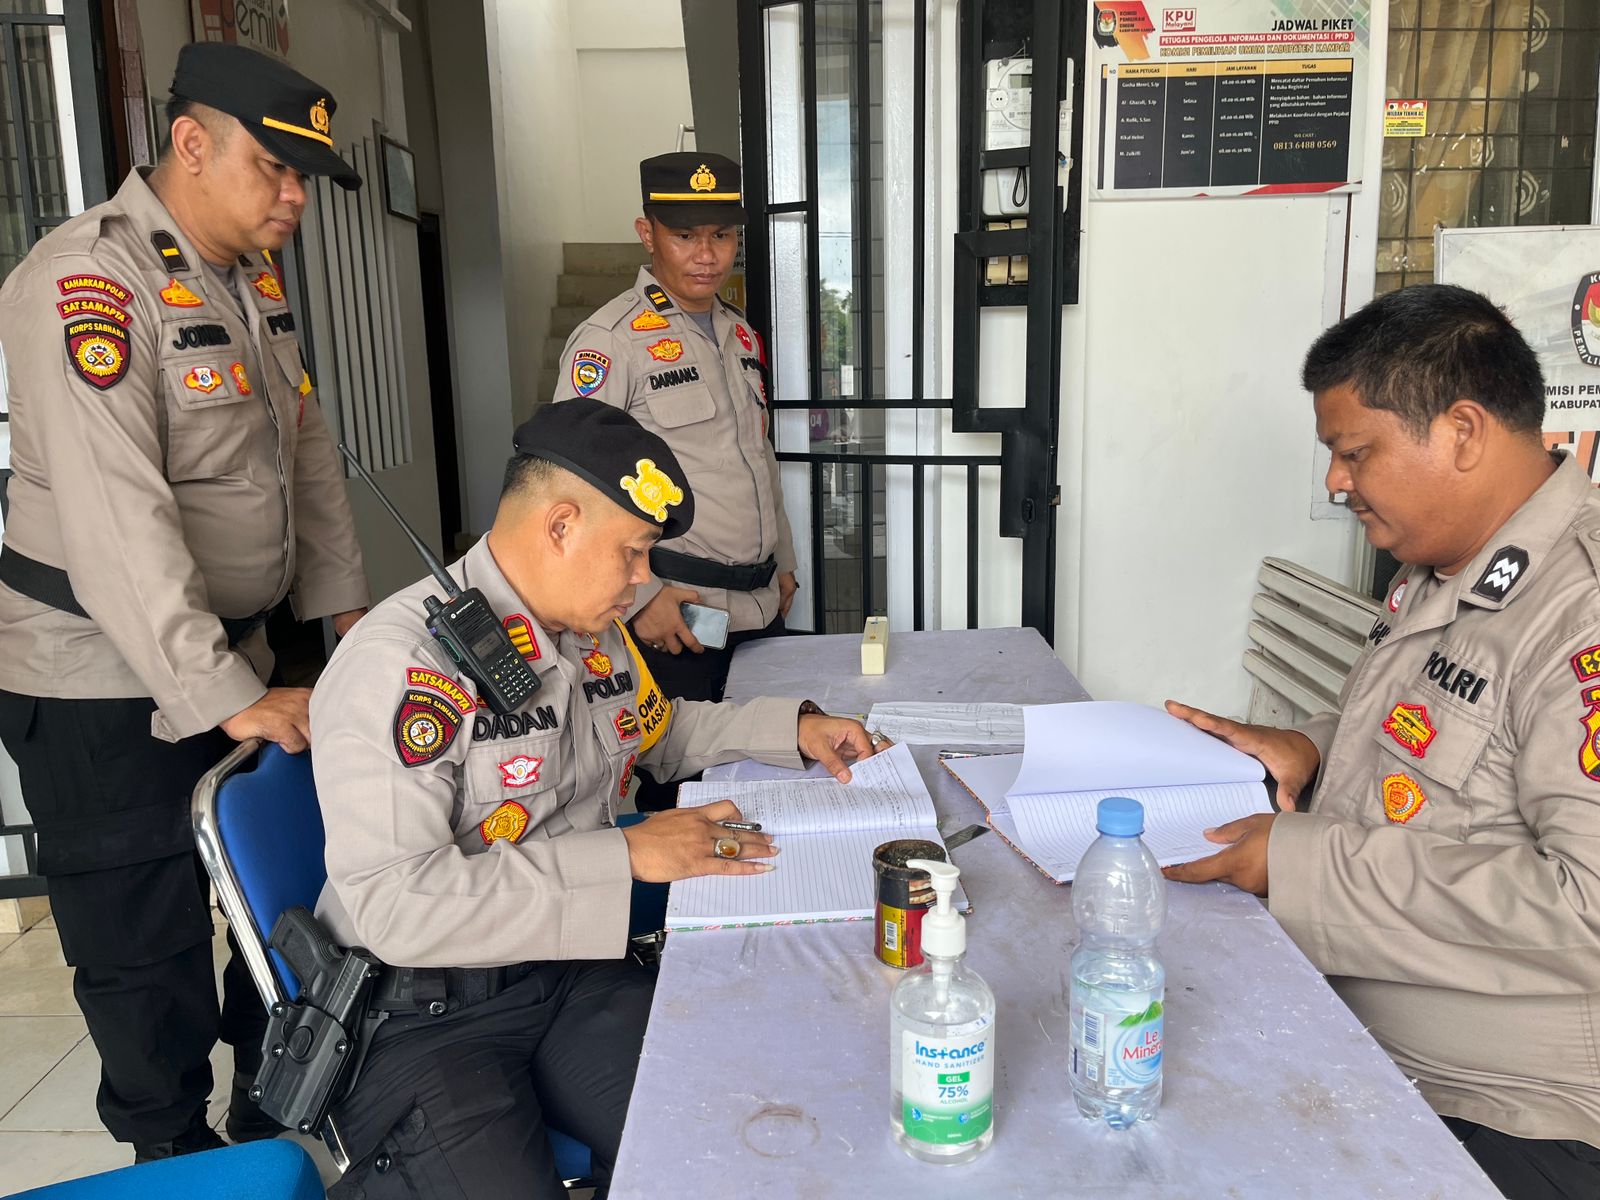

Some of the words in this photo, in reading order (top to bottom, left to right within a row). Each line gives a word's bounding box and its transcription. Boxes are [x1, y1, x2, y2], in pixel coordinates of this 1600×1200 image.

[1165, 11, 1193, 21] KPU
[1272, 20, 1318, 31] JADWAL
[1322, 19, 1353, 30] PIKET
[1162, 36, 1190, 44] PETUGAS
[1192, 35, 1227, 43] PENGELOLA
[1229, 34, 1265, 42] INFORMASI
[1160, 48, 1190, 56] KOMISI
[1192, 46, 1236, 55] PEMILIHAN
[1239, 46, 1264, 54] UMUM
[1267, 44, 1313, 53] KABUPATEN
[1316, 43, 1350, 52] KAMPAR
[1273, 142, 1292, 150] 0813
[1295, 141, 1315, 149] 6488
[1317, 140, 1336, 148] 0569
[64, 278, 105, 291] BAHARKAM
[106, 284, 126, 300] POLRI
[63, 302, 80, 313] SAT
[82, 301, 125, 322] SAMAPTA
[70, 323, 93, 335] KORPS
[94, 323, 125, 339] SABHARA
[1573, 330, 1600, 366] PEMILI
[1546, 385, 1574, 396] MISI
[1422, 651, 1488, 704] POLRI
[411, 672, 470, 710] SATSAMAPTA
[583, 671, 633, 703] POLRI
[409, 694, 432, 704] KORPS
[433, 701, 458, 724] SABHARA
[639, 689, 658, 718] OMB
[472, 706, 558, 741] DADAN
[1146, 1032, 1158, 1045] Le
[916, 1059, 940, 1068] HAND
[944, 1055, 984, 1068] SANITIZER
[938, 1084, 968, 1098] 75%
